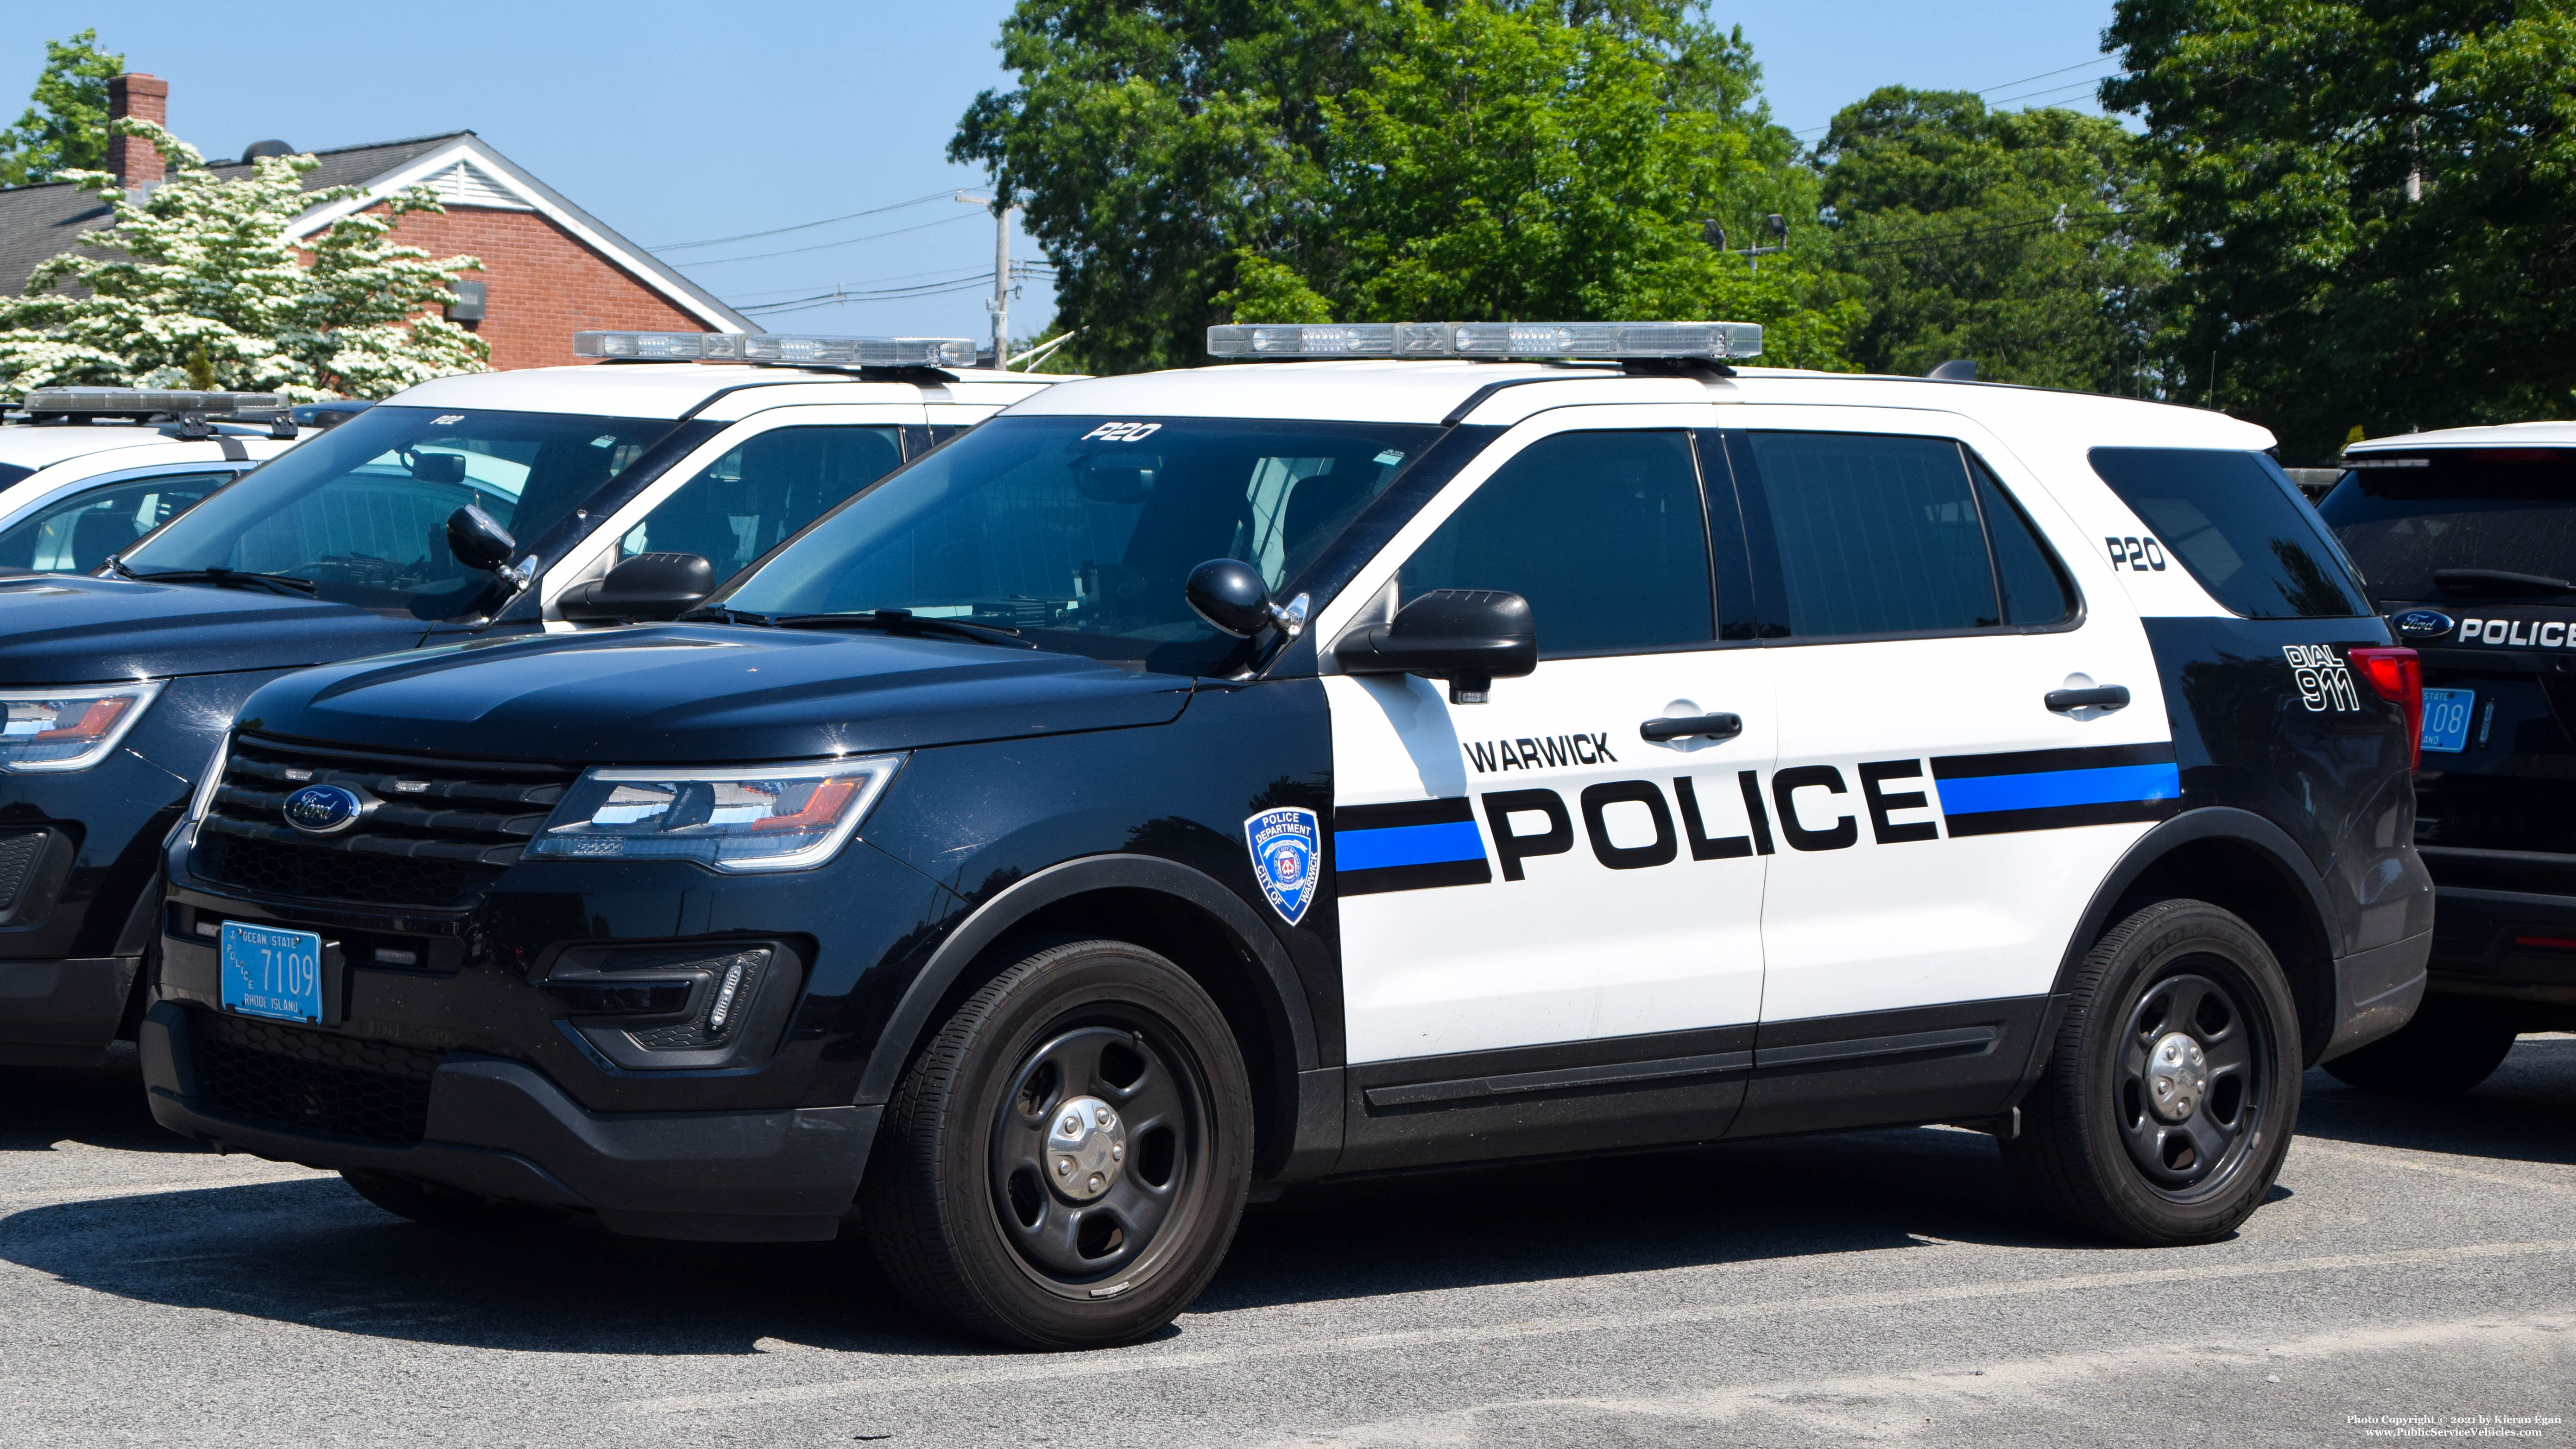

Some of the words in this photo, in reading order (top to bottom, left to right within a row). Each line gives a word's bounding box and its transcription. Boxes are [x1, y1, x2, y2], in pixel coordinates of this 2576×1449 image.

[429, 415, 465, 424] P22
[1080, 422, 1162, 442] P20
[2104, 537, 2166, 571] P20
[2401, 614, 2437, 631] Ford
[2282, 645, 2345, 668] DIAL
[2295, 668, 2360, 711] 911
[2424, 692, 2449, 701] STATE
[1463, 732, 1618, 773] WARWICK
[293, 791, 338, 820] Ford
[1262, 812, 1300, 827] POLICE
[1481, 758, 1940, 882] POLICE
[1255, 823, 1312, 844] DEPARTMENT
[1257, 865, 1274, 891] CITY
[1270, 891, 1282, 905] OF
[1301, 851, 1318, 904] WARWICK
[243, 931, 267, 945] OCEAN
[271, 935, 297, 949] STATE
[227, 944, 254, 989] POLICE
[261, 949, 313, 997] 7109
[244, 993, 267, 1008] RHODE
[271, 997, 298, 1012] ISLAND
